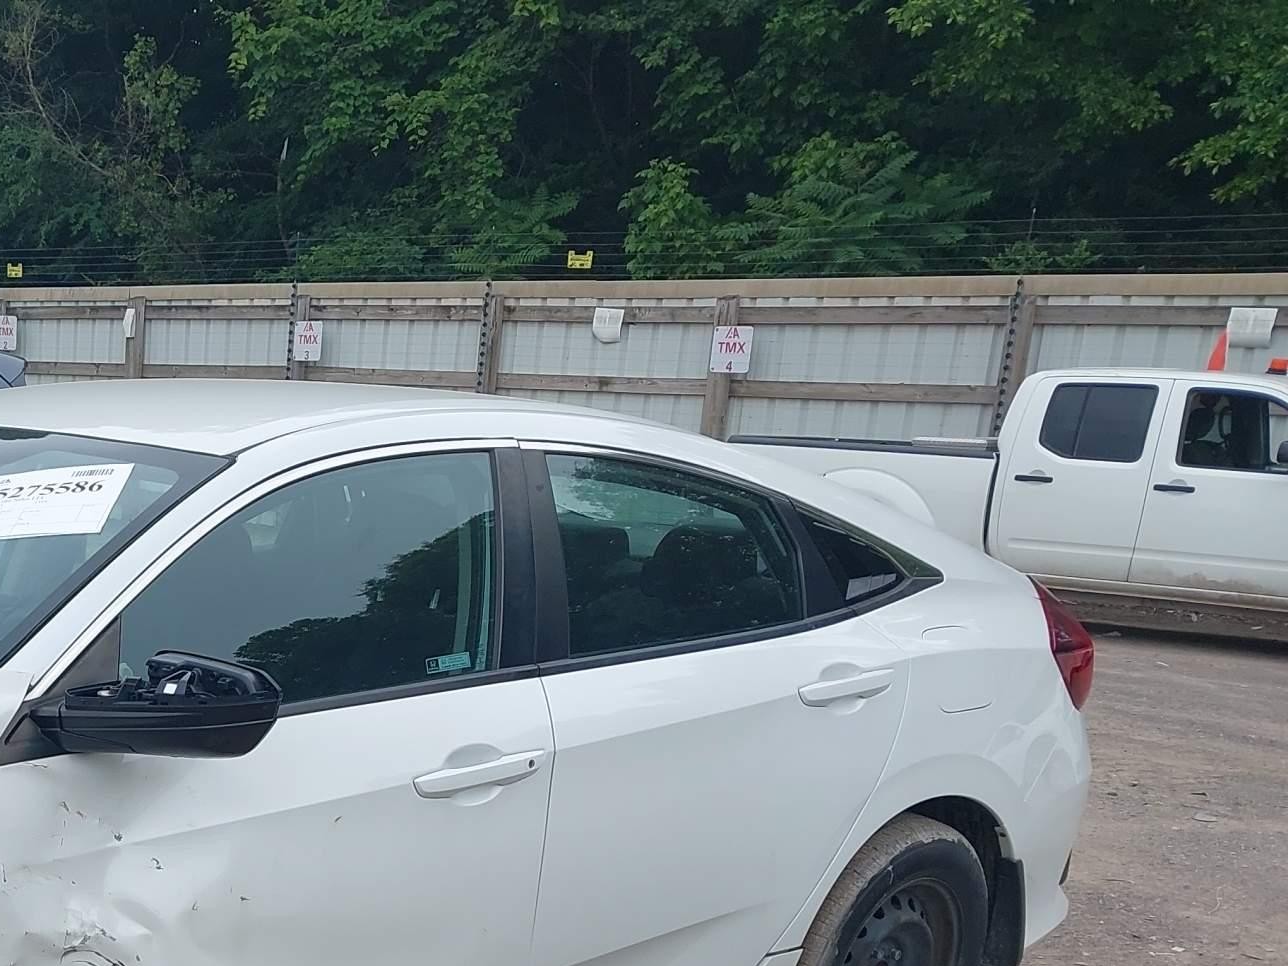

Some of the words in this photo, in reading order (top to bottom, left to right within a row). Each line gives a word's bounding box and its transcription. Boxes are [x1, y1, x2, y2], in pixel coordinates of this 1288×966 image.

[298, 334, 319, 345] TMX
[3, 341, 8, 350] 2
[718, 341, 746, 354] TMX
[304, 350, 310, 360] 3
[725, 360, 733, 372] 4
